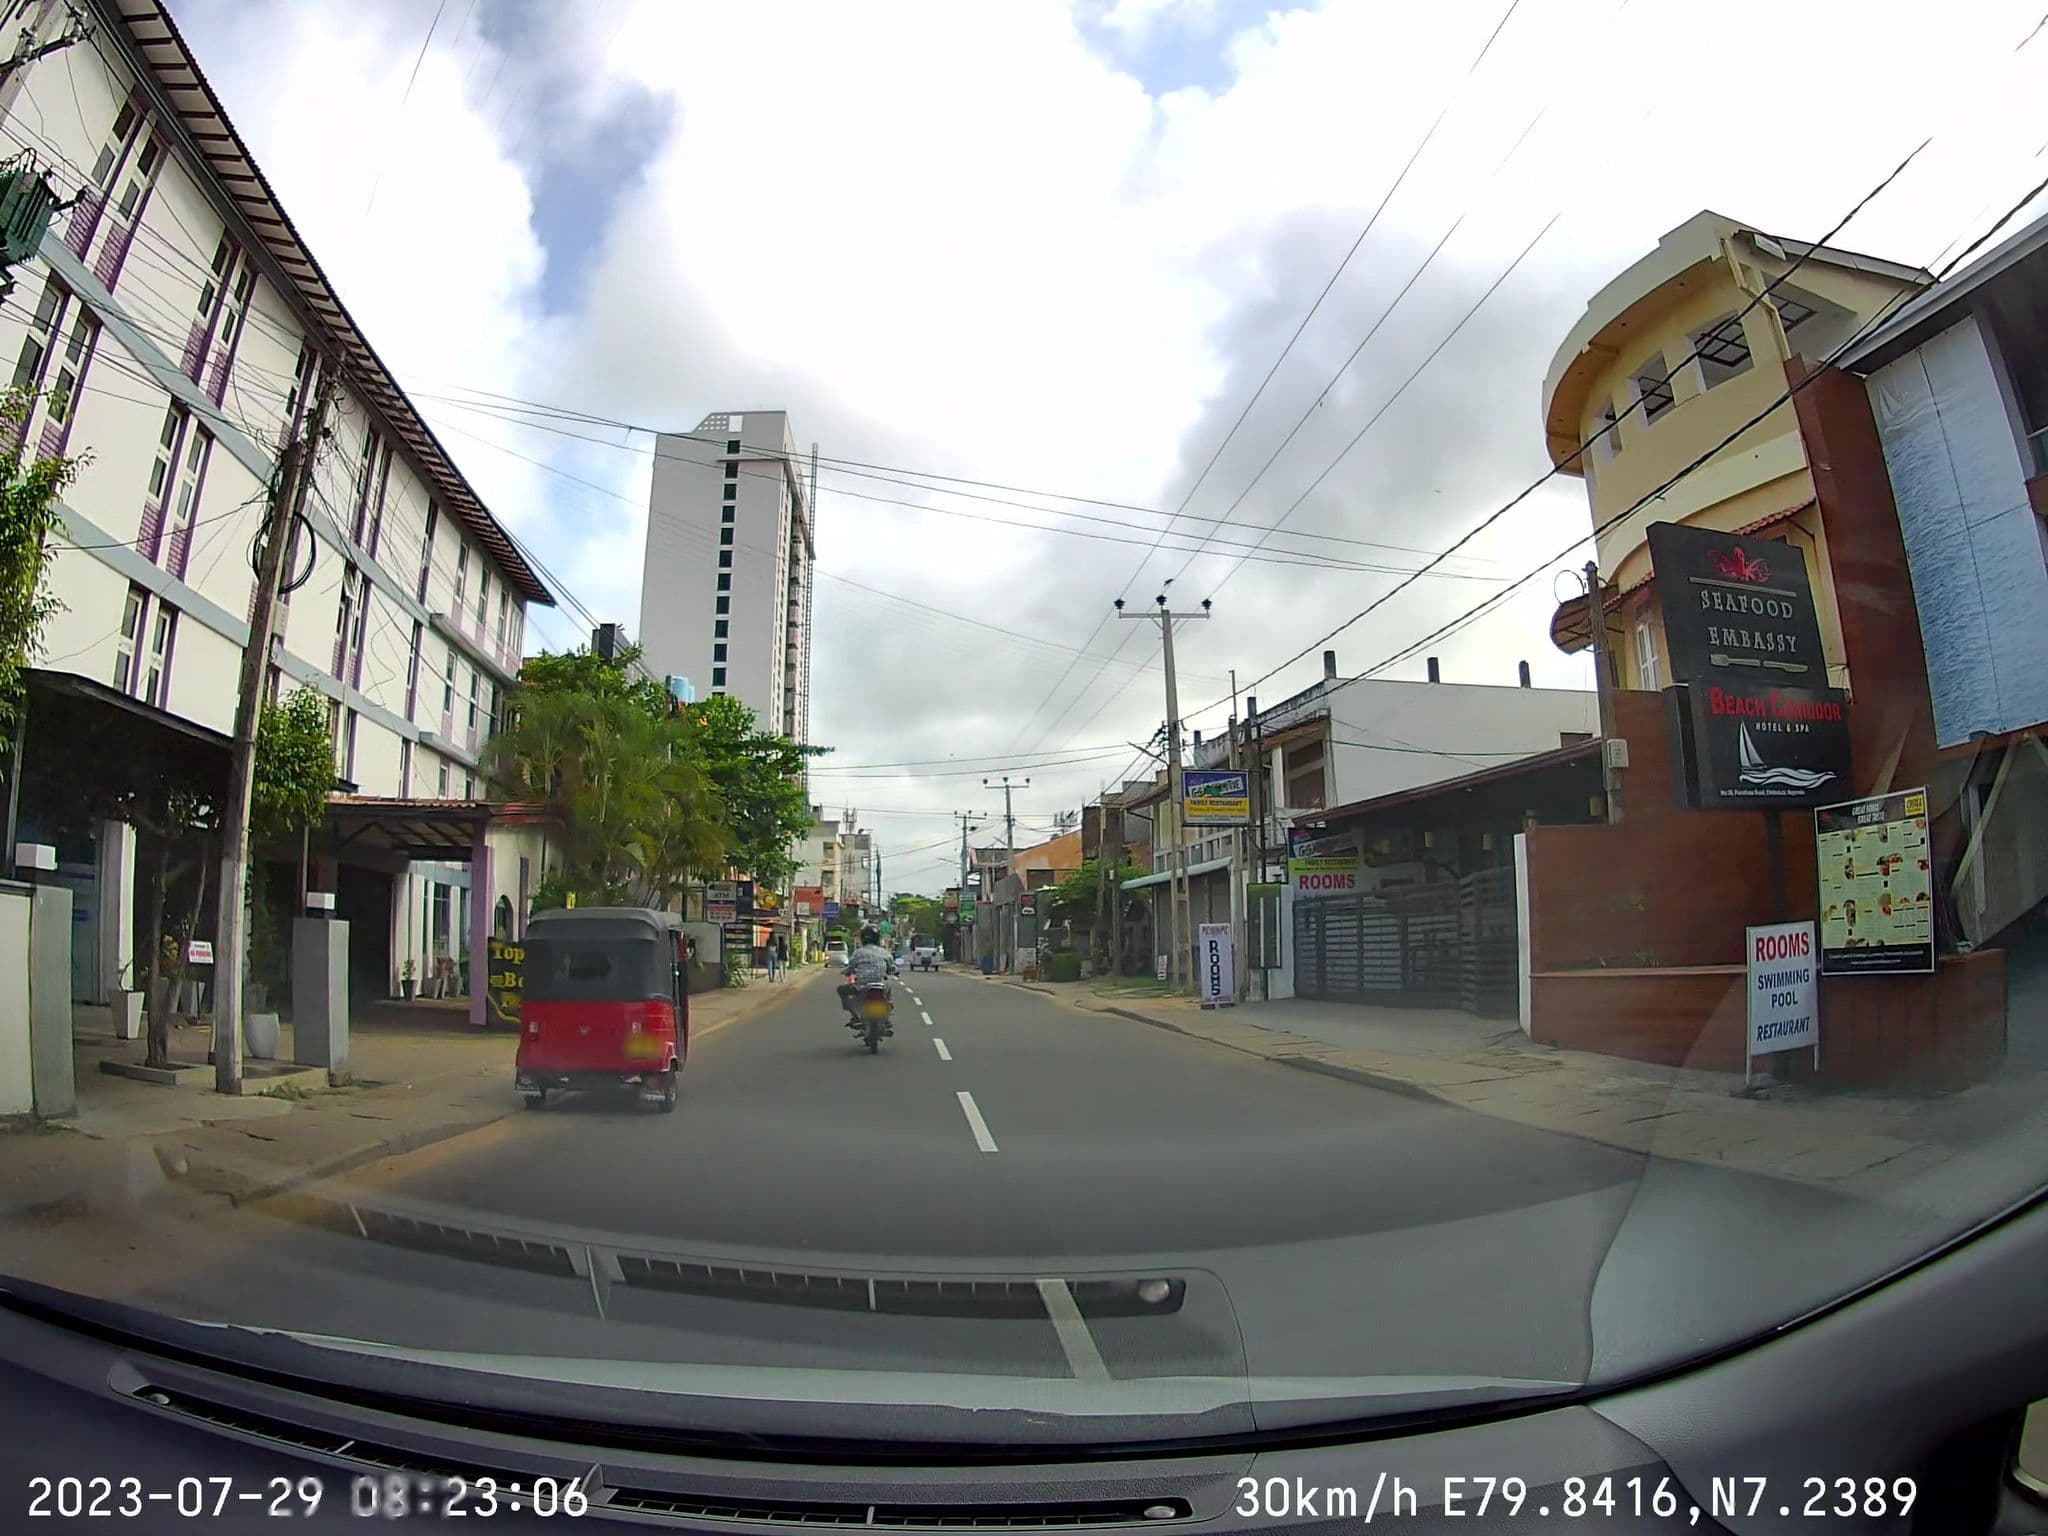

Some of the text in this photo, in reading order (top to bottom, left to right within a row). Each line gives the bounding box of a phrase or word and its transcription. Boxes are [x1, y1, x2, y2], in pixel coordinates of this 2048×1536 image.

[1701, 589, 1793, 619] SEAFOOD
[1708, 626, 1797, 652] EMBASSY
[1755, 722, 1782, 732] HOTEL
[1795, 724, 1810, 733] SPA
[1299, 873, 1356, 890] ROOMS
[1755, 932, 1810, 963] ROOMS
[1209, 940, 1221, 996] ROOMS
[1757, 967, 1810, 991] SWIMMING
[1771, 990, 1798, 1008] POOL
[1756, 1016, 1811, 1042] RESTAURANT
